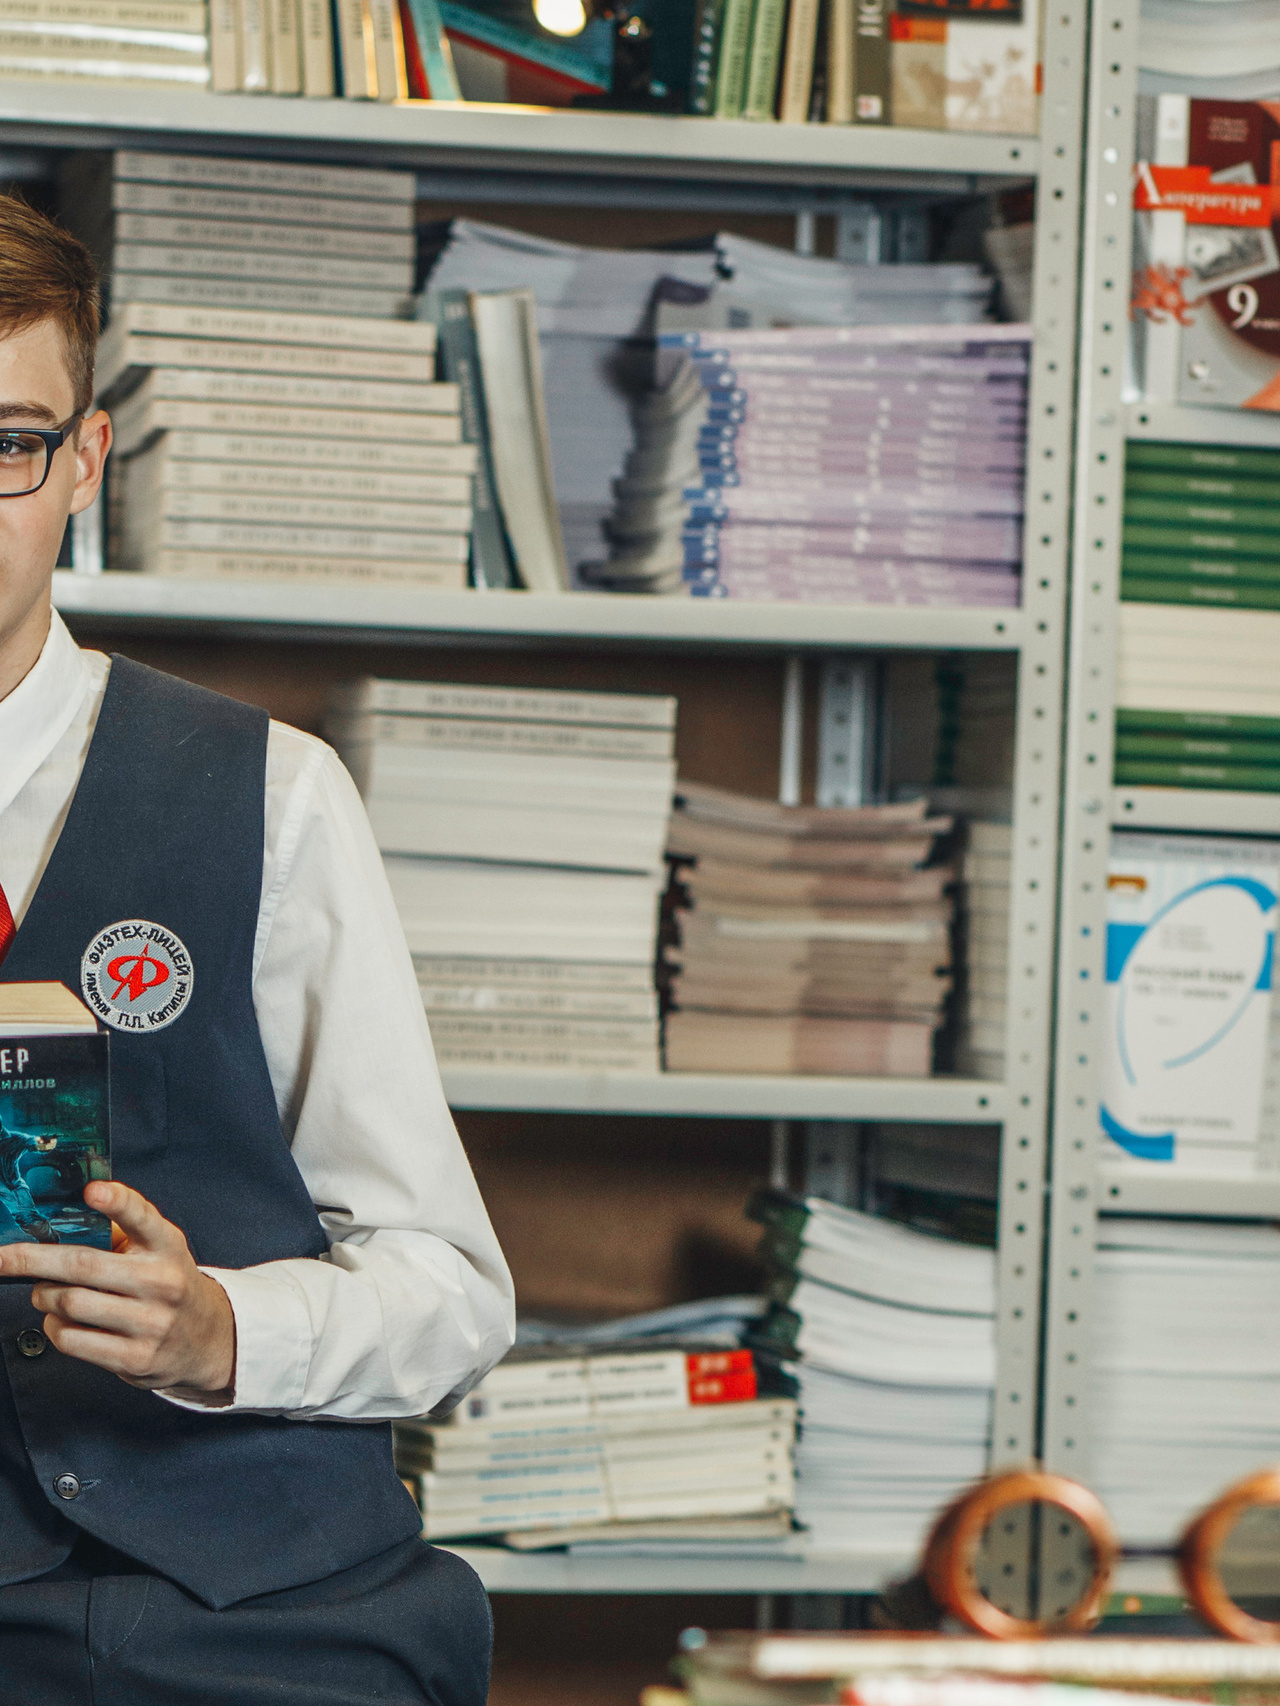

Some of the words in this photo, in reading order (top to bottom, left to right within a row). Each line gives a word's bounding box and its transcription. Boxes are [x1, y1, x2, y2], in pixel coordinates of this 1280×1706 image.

[1227, 284, 1259, 331] 9
[89, 925, 191, 976] ФИЗТЕХ-ЛИЦЕЙ
[86, 972, 112, 1016] имени
[147, 981, 187, 1026] Капицы
